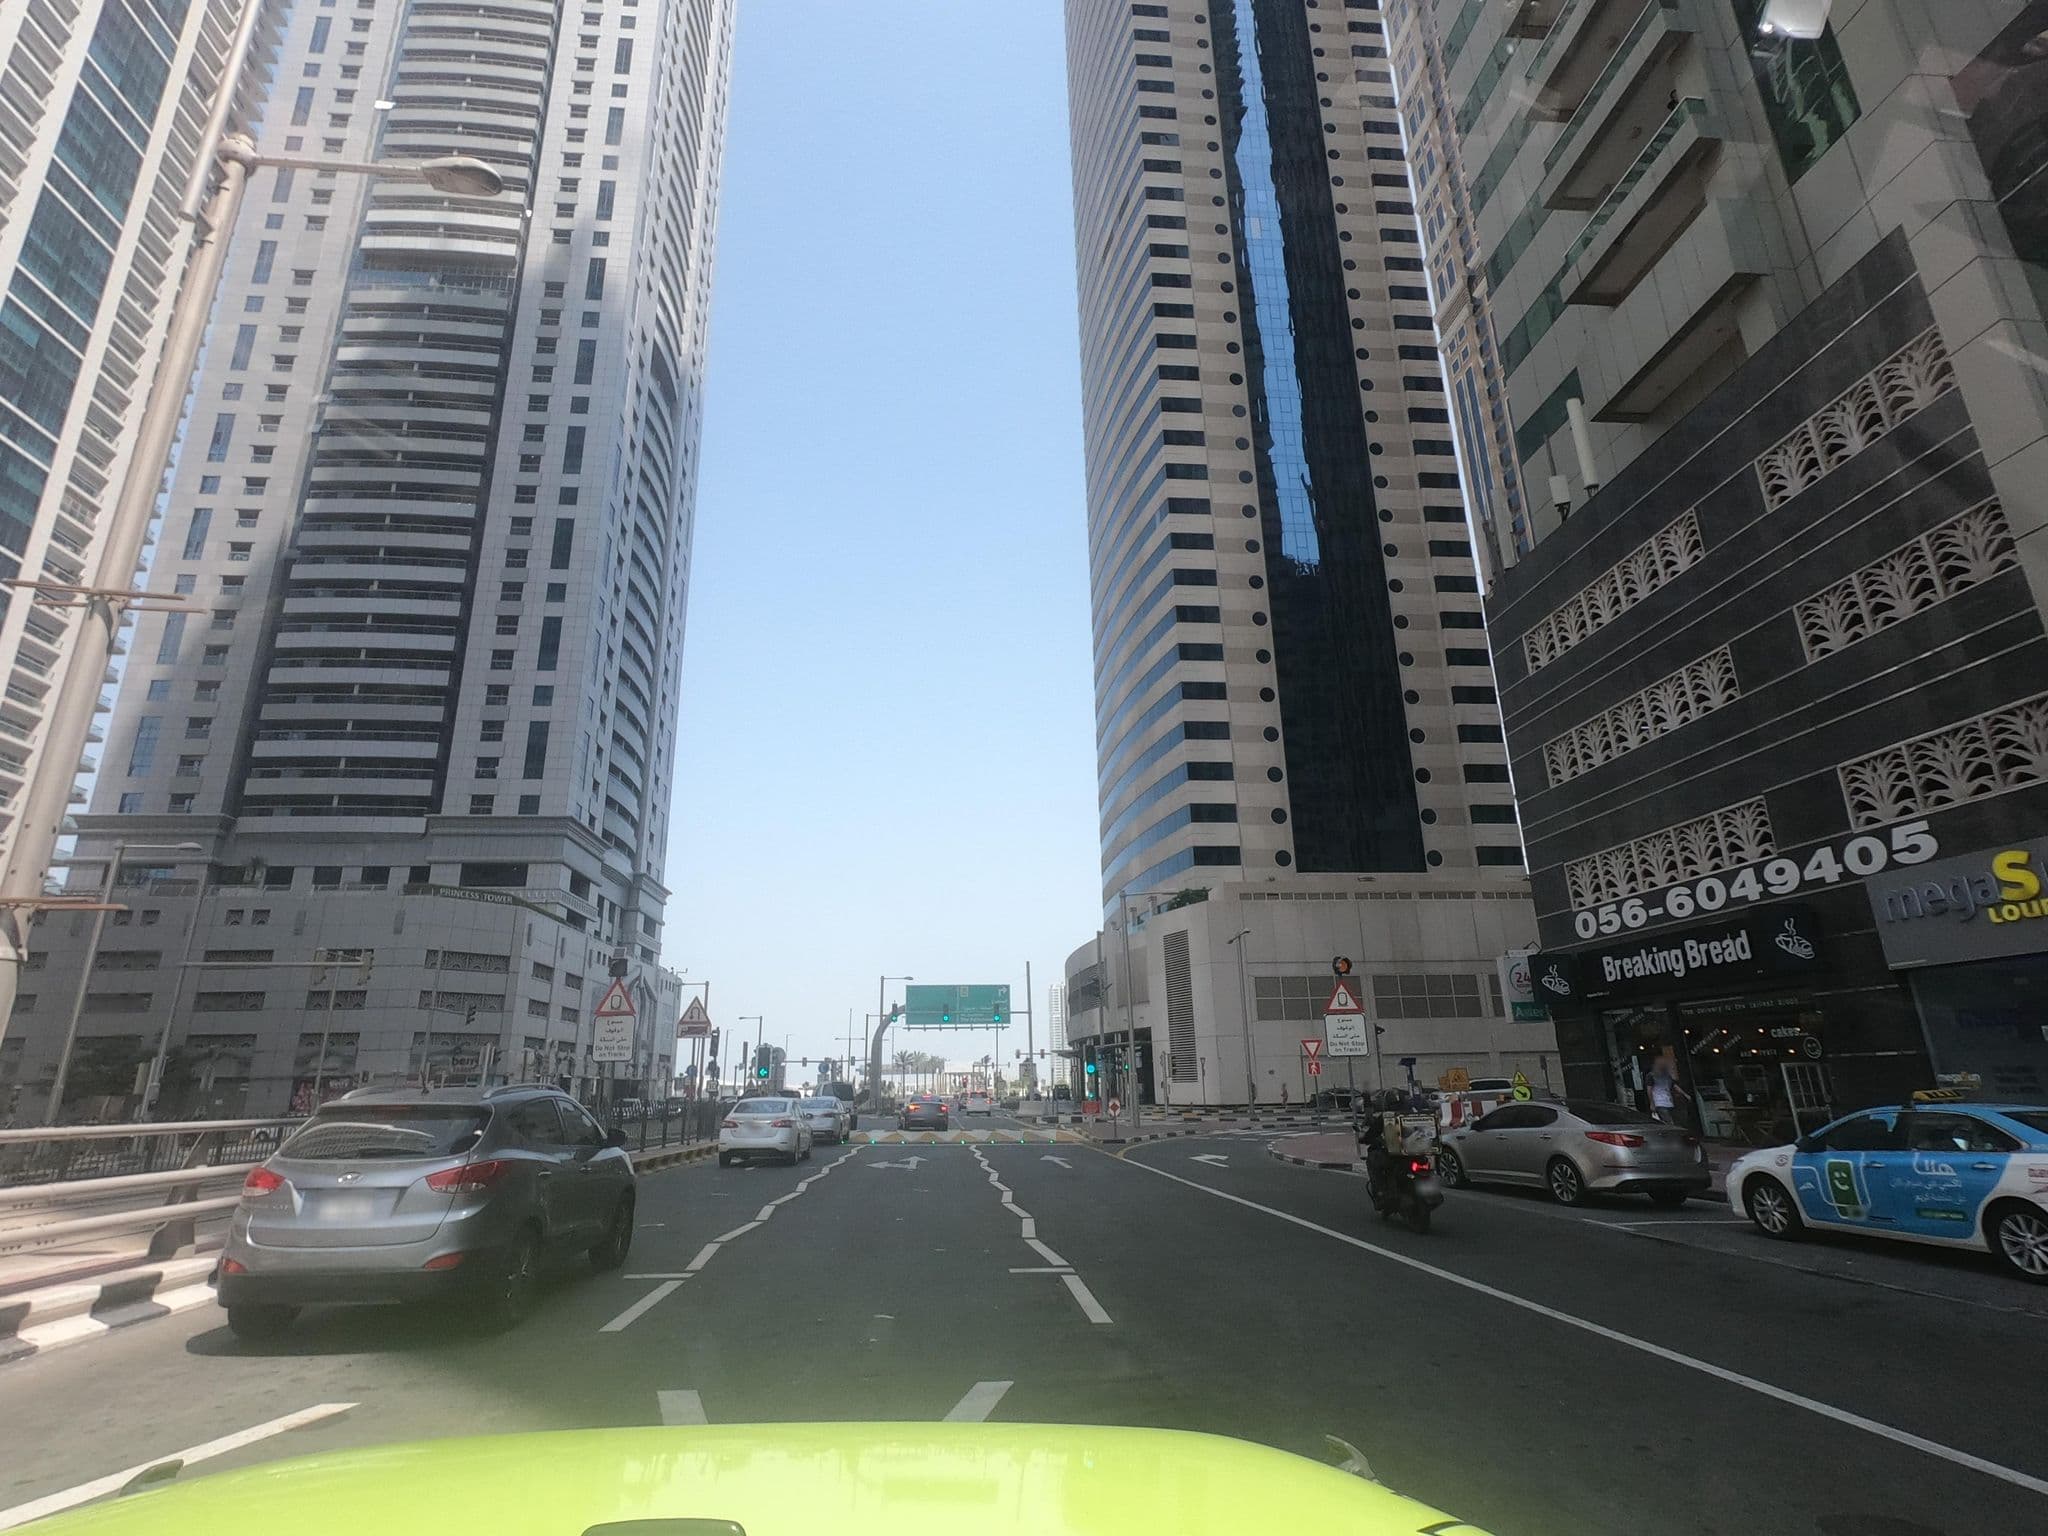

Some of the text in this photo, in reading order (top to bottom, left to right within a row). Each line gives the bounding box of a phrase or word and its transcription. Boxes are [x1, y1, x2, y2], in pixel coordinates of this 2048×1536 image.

[440, 887, 513, 904] PRINCESS TOWER
[1574, 819, 1939, 939] 056-6049405
[1603, 929, 1752, 983] Breaking Bread
